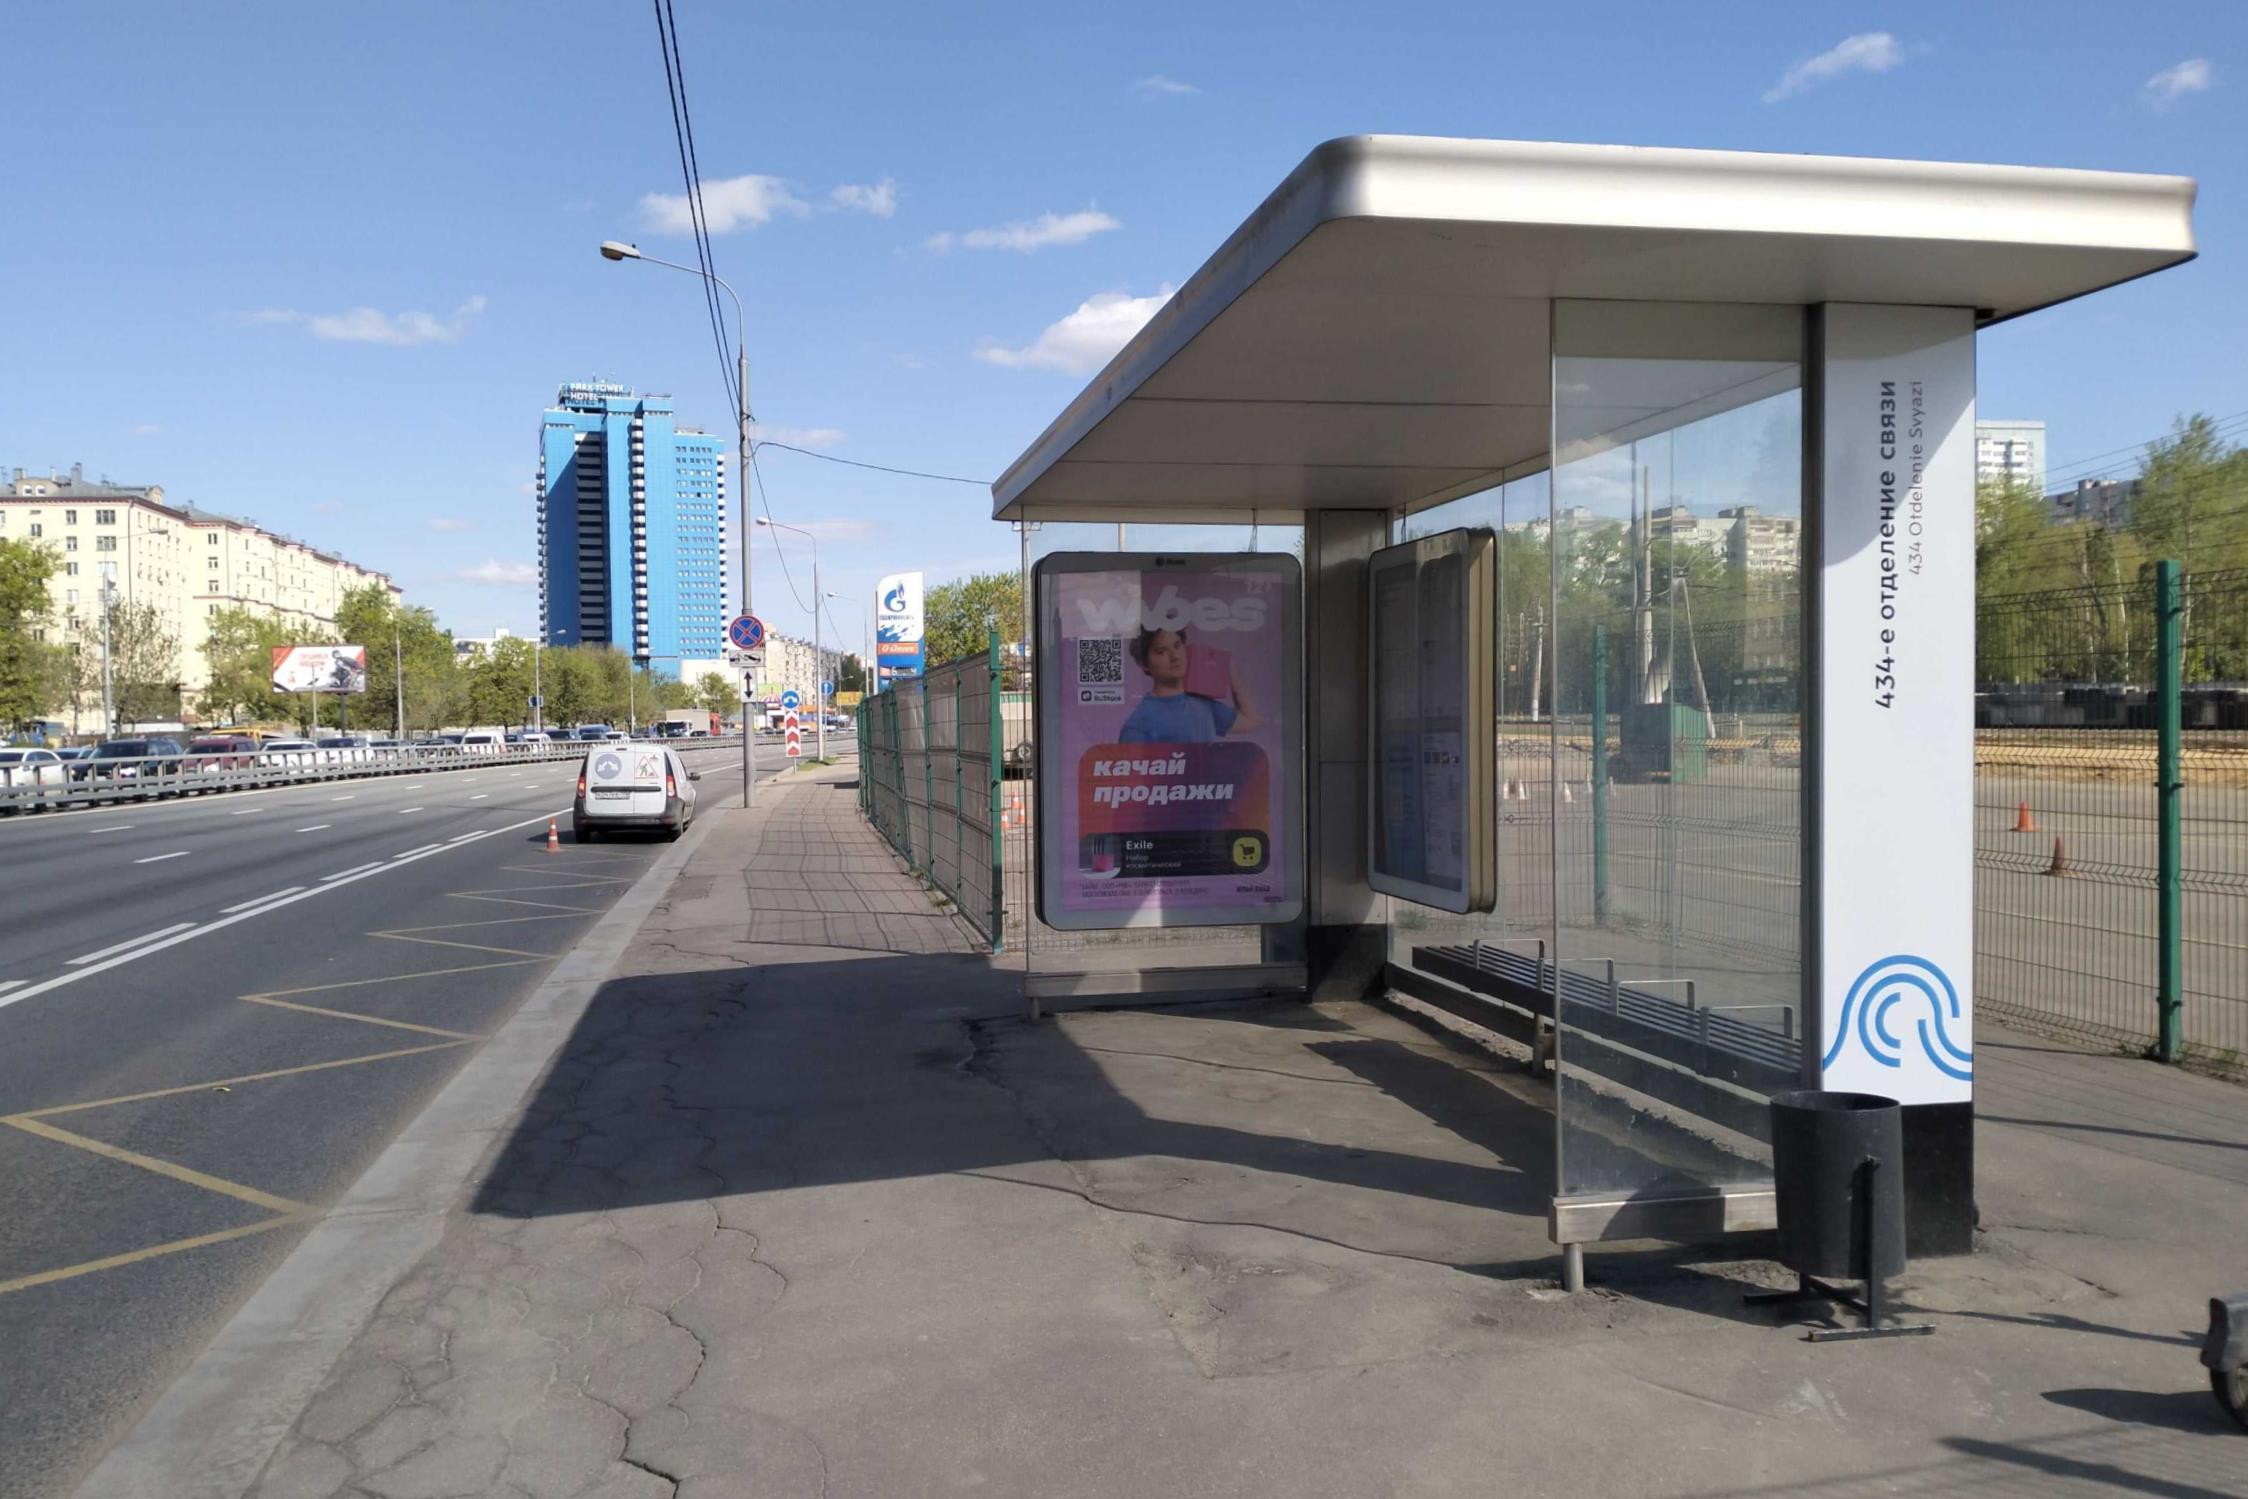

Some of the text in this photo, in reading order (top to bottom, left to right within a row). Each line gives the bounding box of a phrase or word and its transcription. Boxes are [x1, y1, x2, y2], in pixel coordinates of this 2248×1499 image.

[1909, 380, 1927, 576] 434 Otdelenie Svyazi
[1875, 381, 1899, 709] 434-е отделение связи
[1094, 752, 1186, 776] качай
[1093, 782, 1234, 808] продажи
[1126, 839, 1154, 851] Exile
